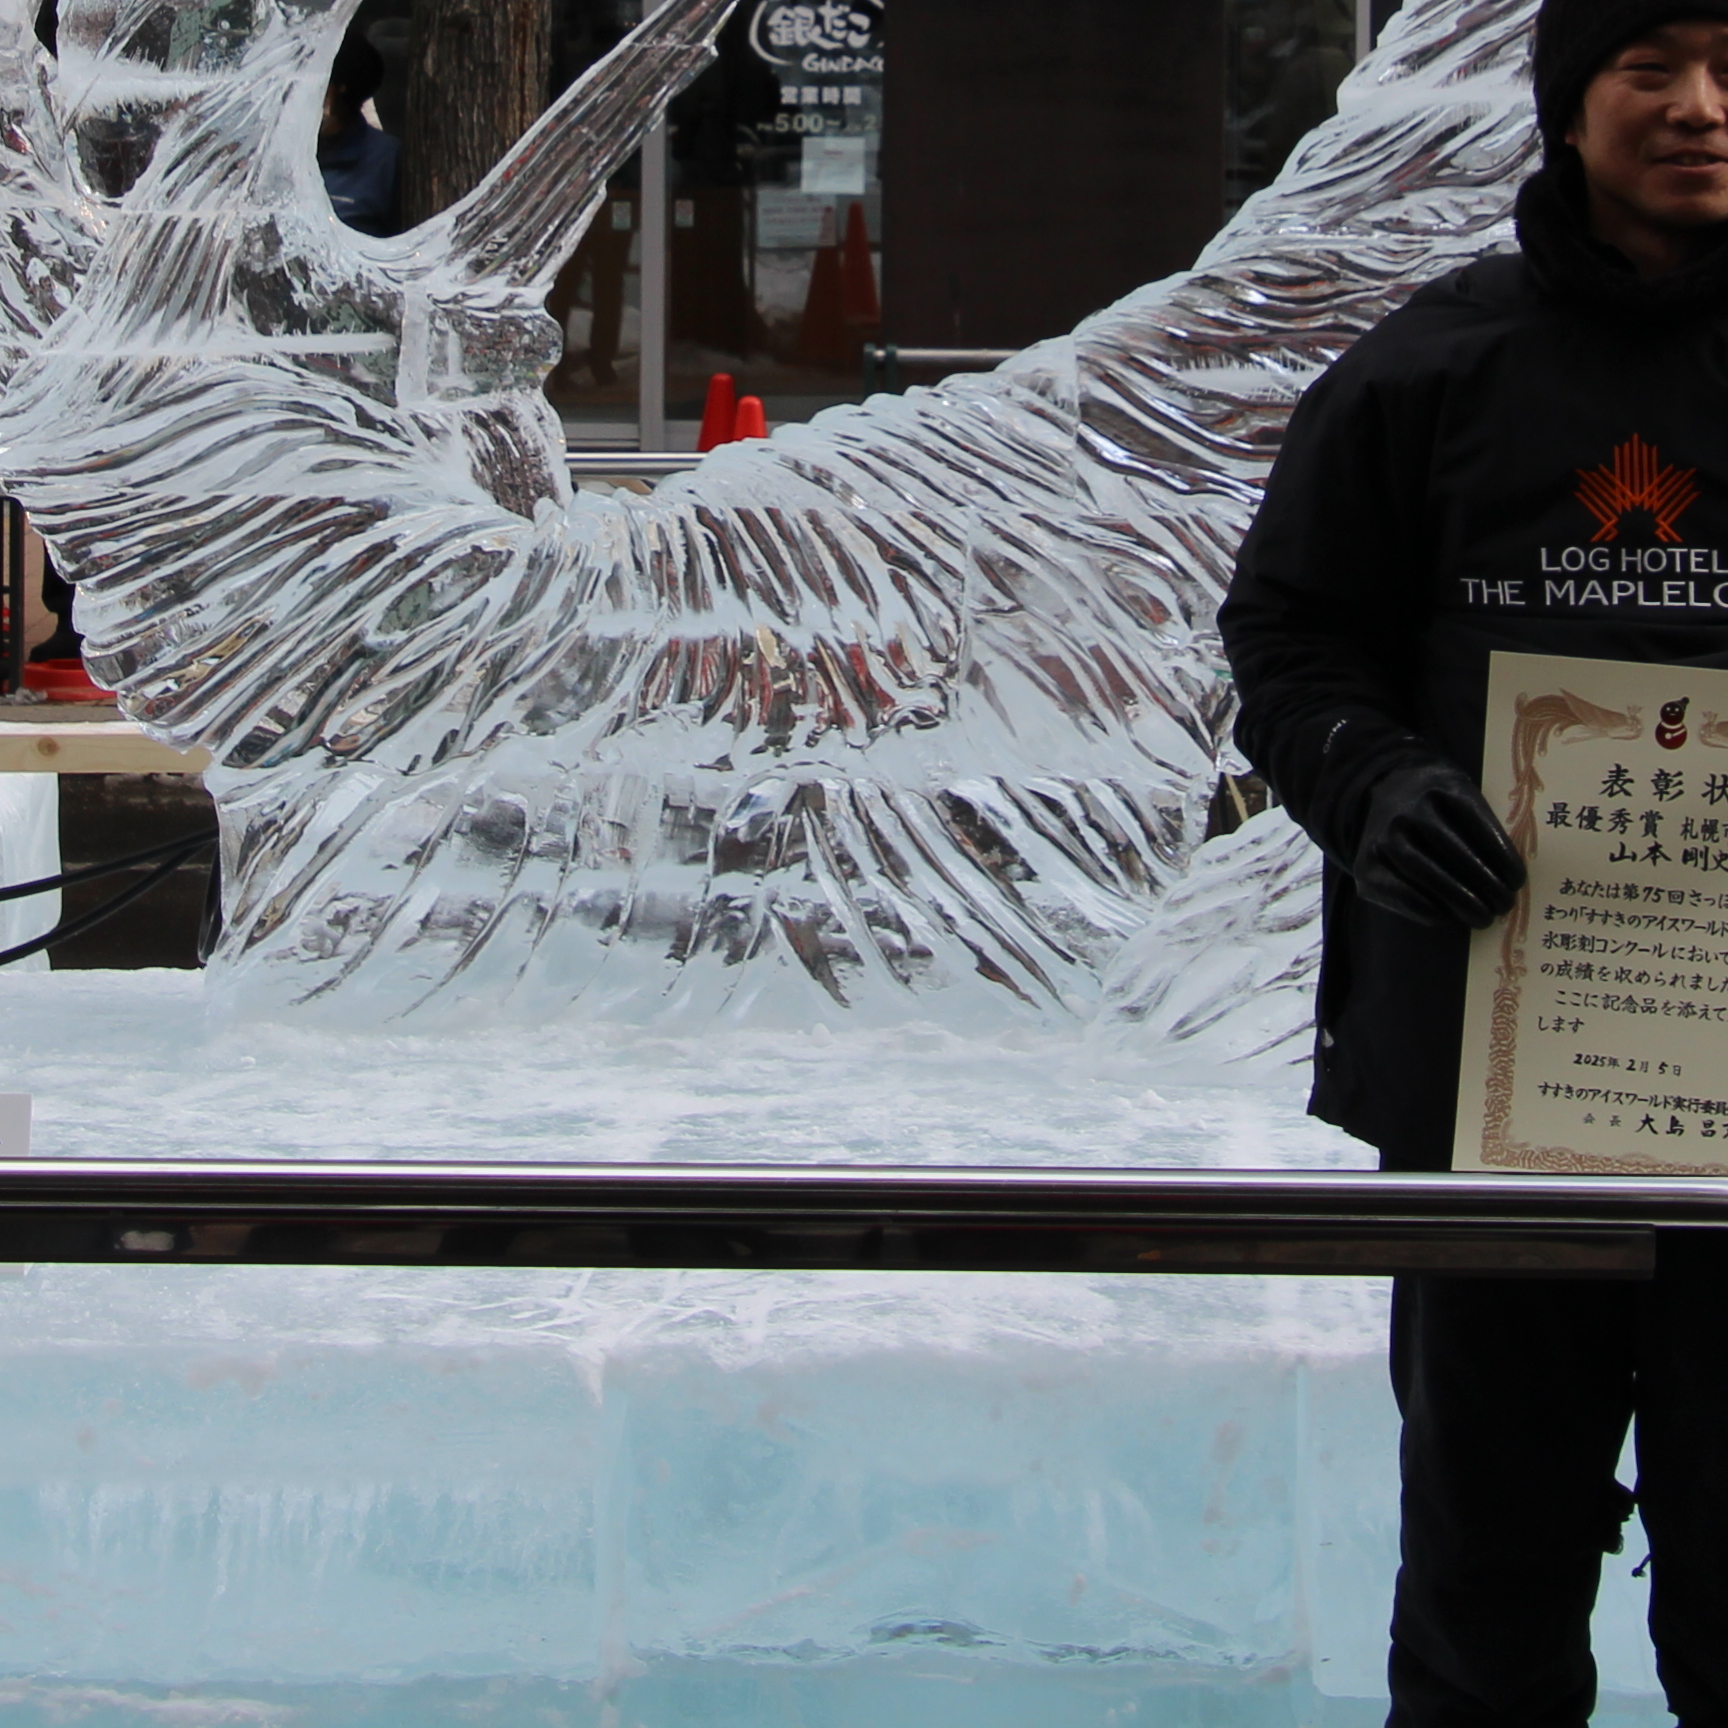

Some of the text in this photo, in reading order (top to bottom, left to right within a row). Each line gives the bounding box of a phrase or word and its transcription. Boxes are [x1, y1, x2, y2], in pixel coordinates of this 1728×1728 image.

[767, 0, 871, 50] 銀だこ
[802, 52, 885, 72] GINDAC
[781, 86, 862, 105] 営業時間
[1540, 547, 1611, 573] LOG
[1459, 578, 1527, 606] THE
[1546, 801, 1664, 839] 最優秀賞
[1537, 1016, 1585, 1034] します
